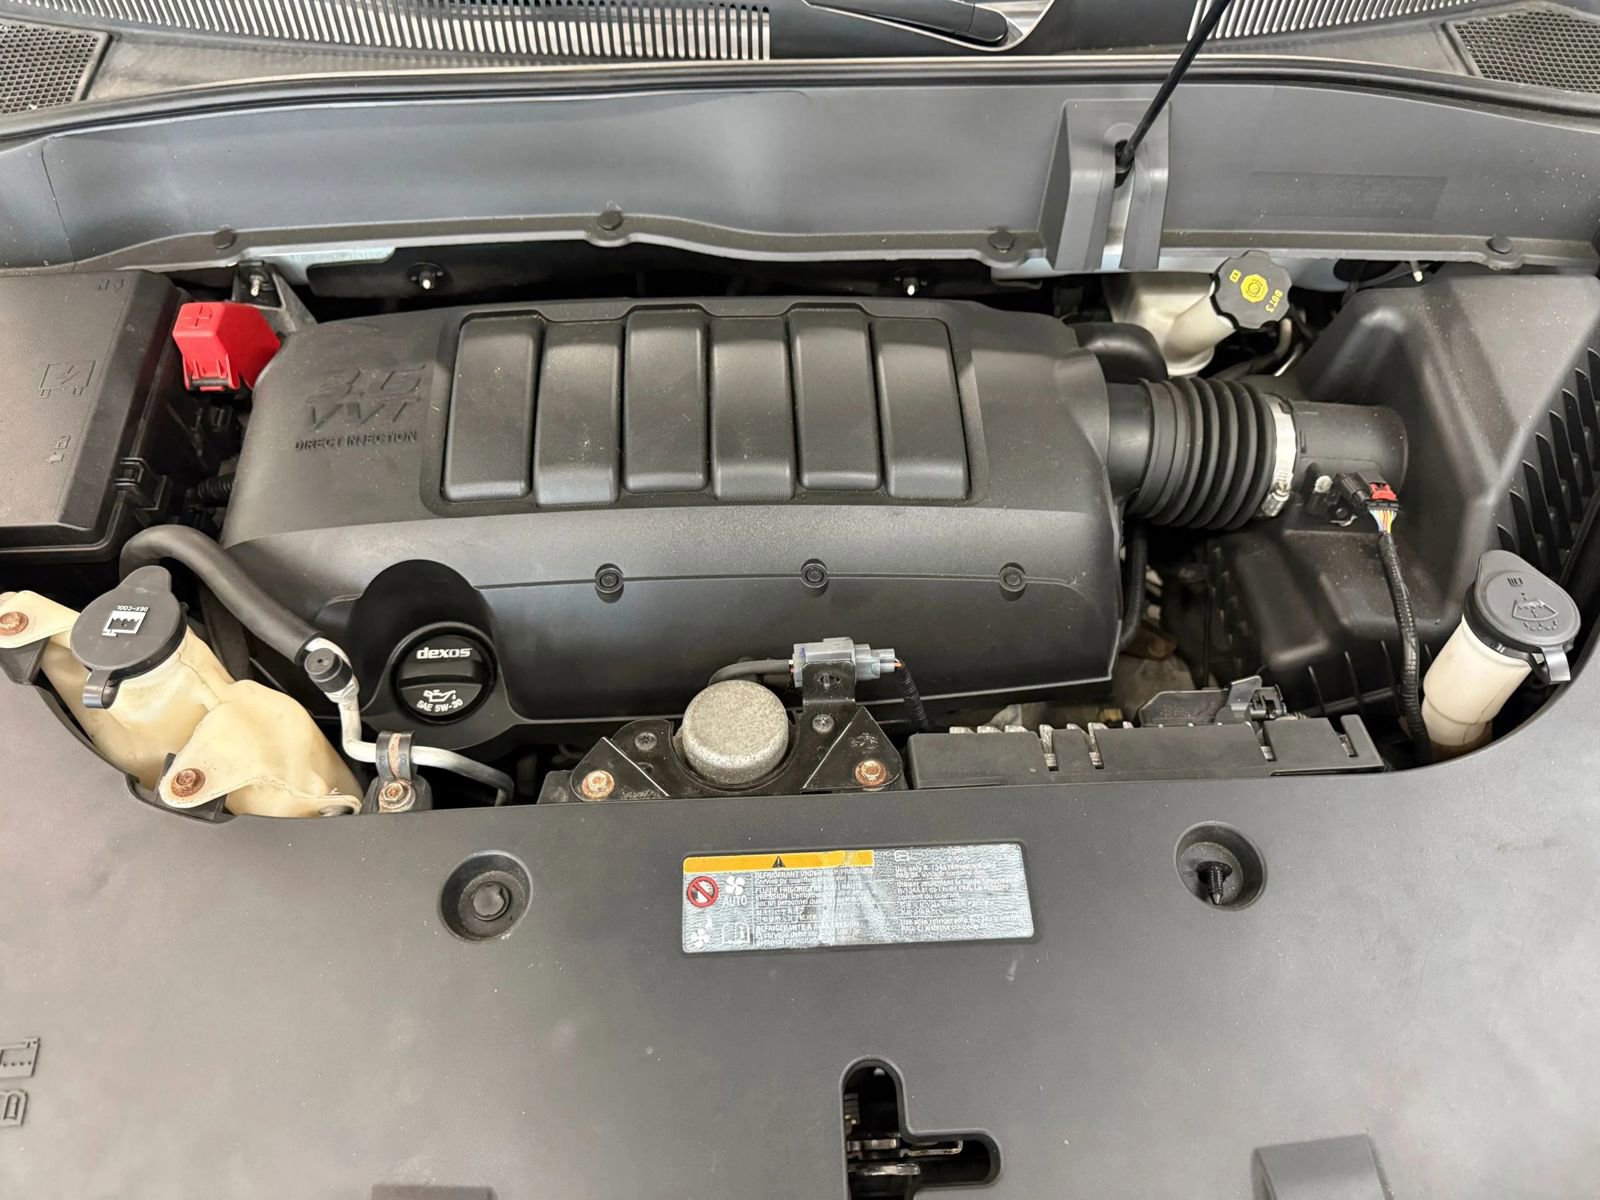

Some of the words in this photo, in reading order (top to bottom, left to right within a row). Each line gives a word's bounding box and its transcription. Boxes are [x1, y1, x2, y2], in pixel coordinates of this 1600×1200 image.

[295, 436, 343, 450] DIRECT
[346, 431, 417, 447] INJECTION
[416, 647, 473, 659] dexos
[416, 700, 433, 712] SAE
[435, 699, 463, 712] 5W-30
[723, 896, 748, 906] AUTO
